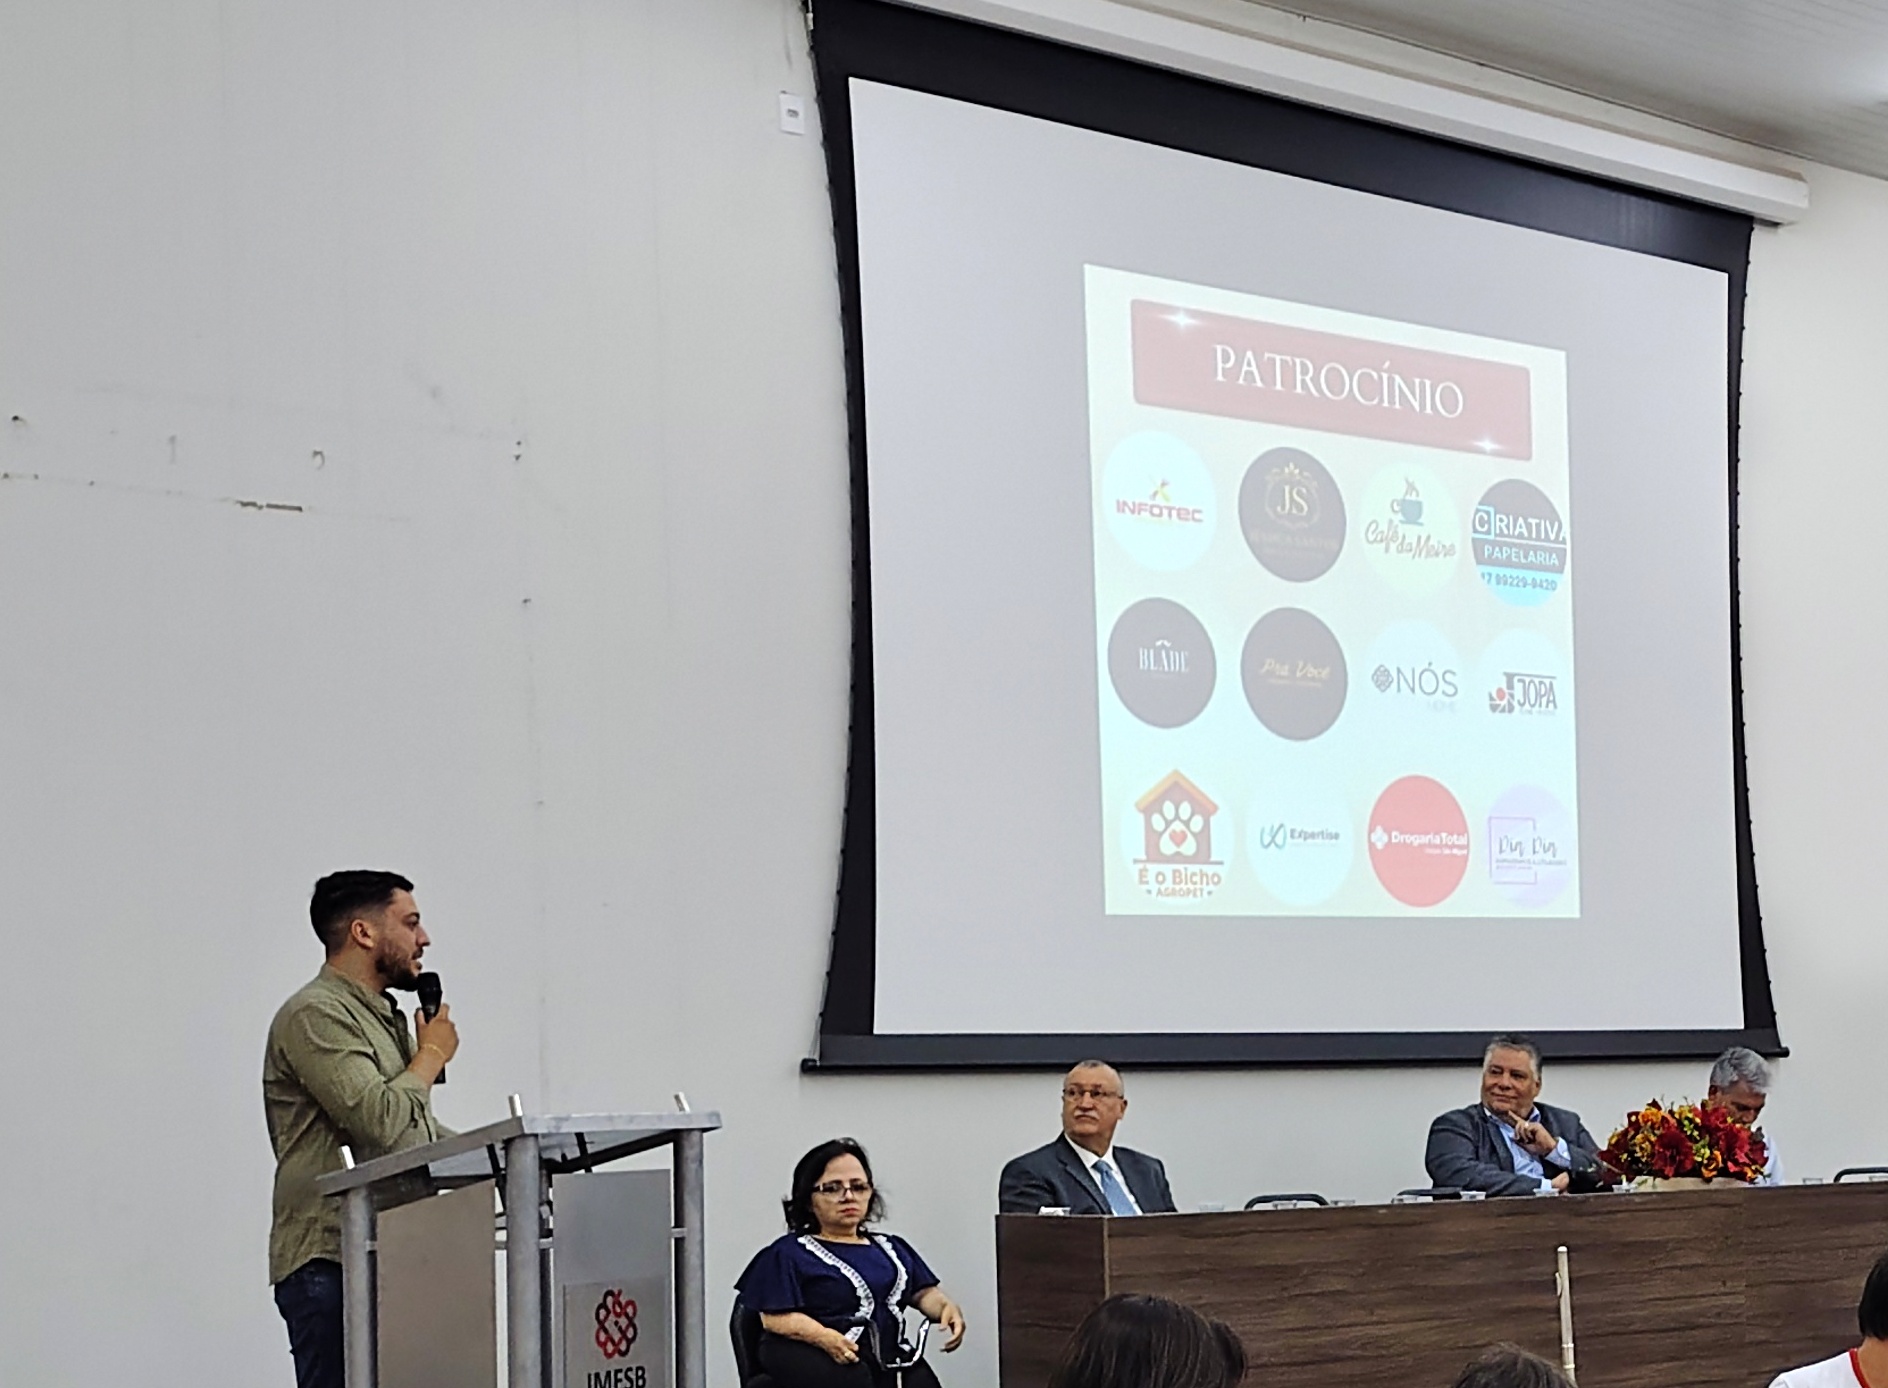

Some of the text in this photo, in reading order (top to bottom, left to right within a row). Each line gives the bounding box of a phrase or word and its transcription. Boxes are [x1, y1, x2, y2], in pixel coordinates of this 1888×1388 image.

[1214, 345, 1464, 418] PATROCÍNIO
[1277, 484, 1309, 516] JS
[1365, 518, 1400, 554] Café
[1484, 544, 1559, 567] PAPELARIA
[1396, 661, 1459, 698] NÓS
[1517, 678, 1558, 710] JOPA
[1138, 864, 1223, 887] É o Bicho
[1156, 887, 1205, 898] AGROPET
